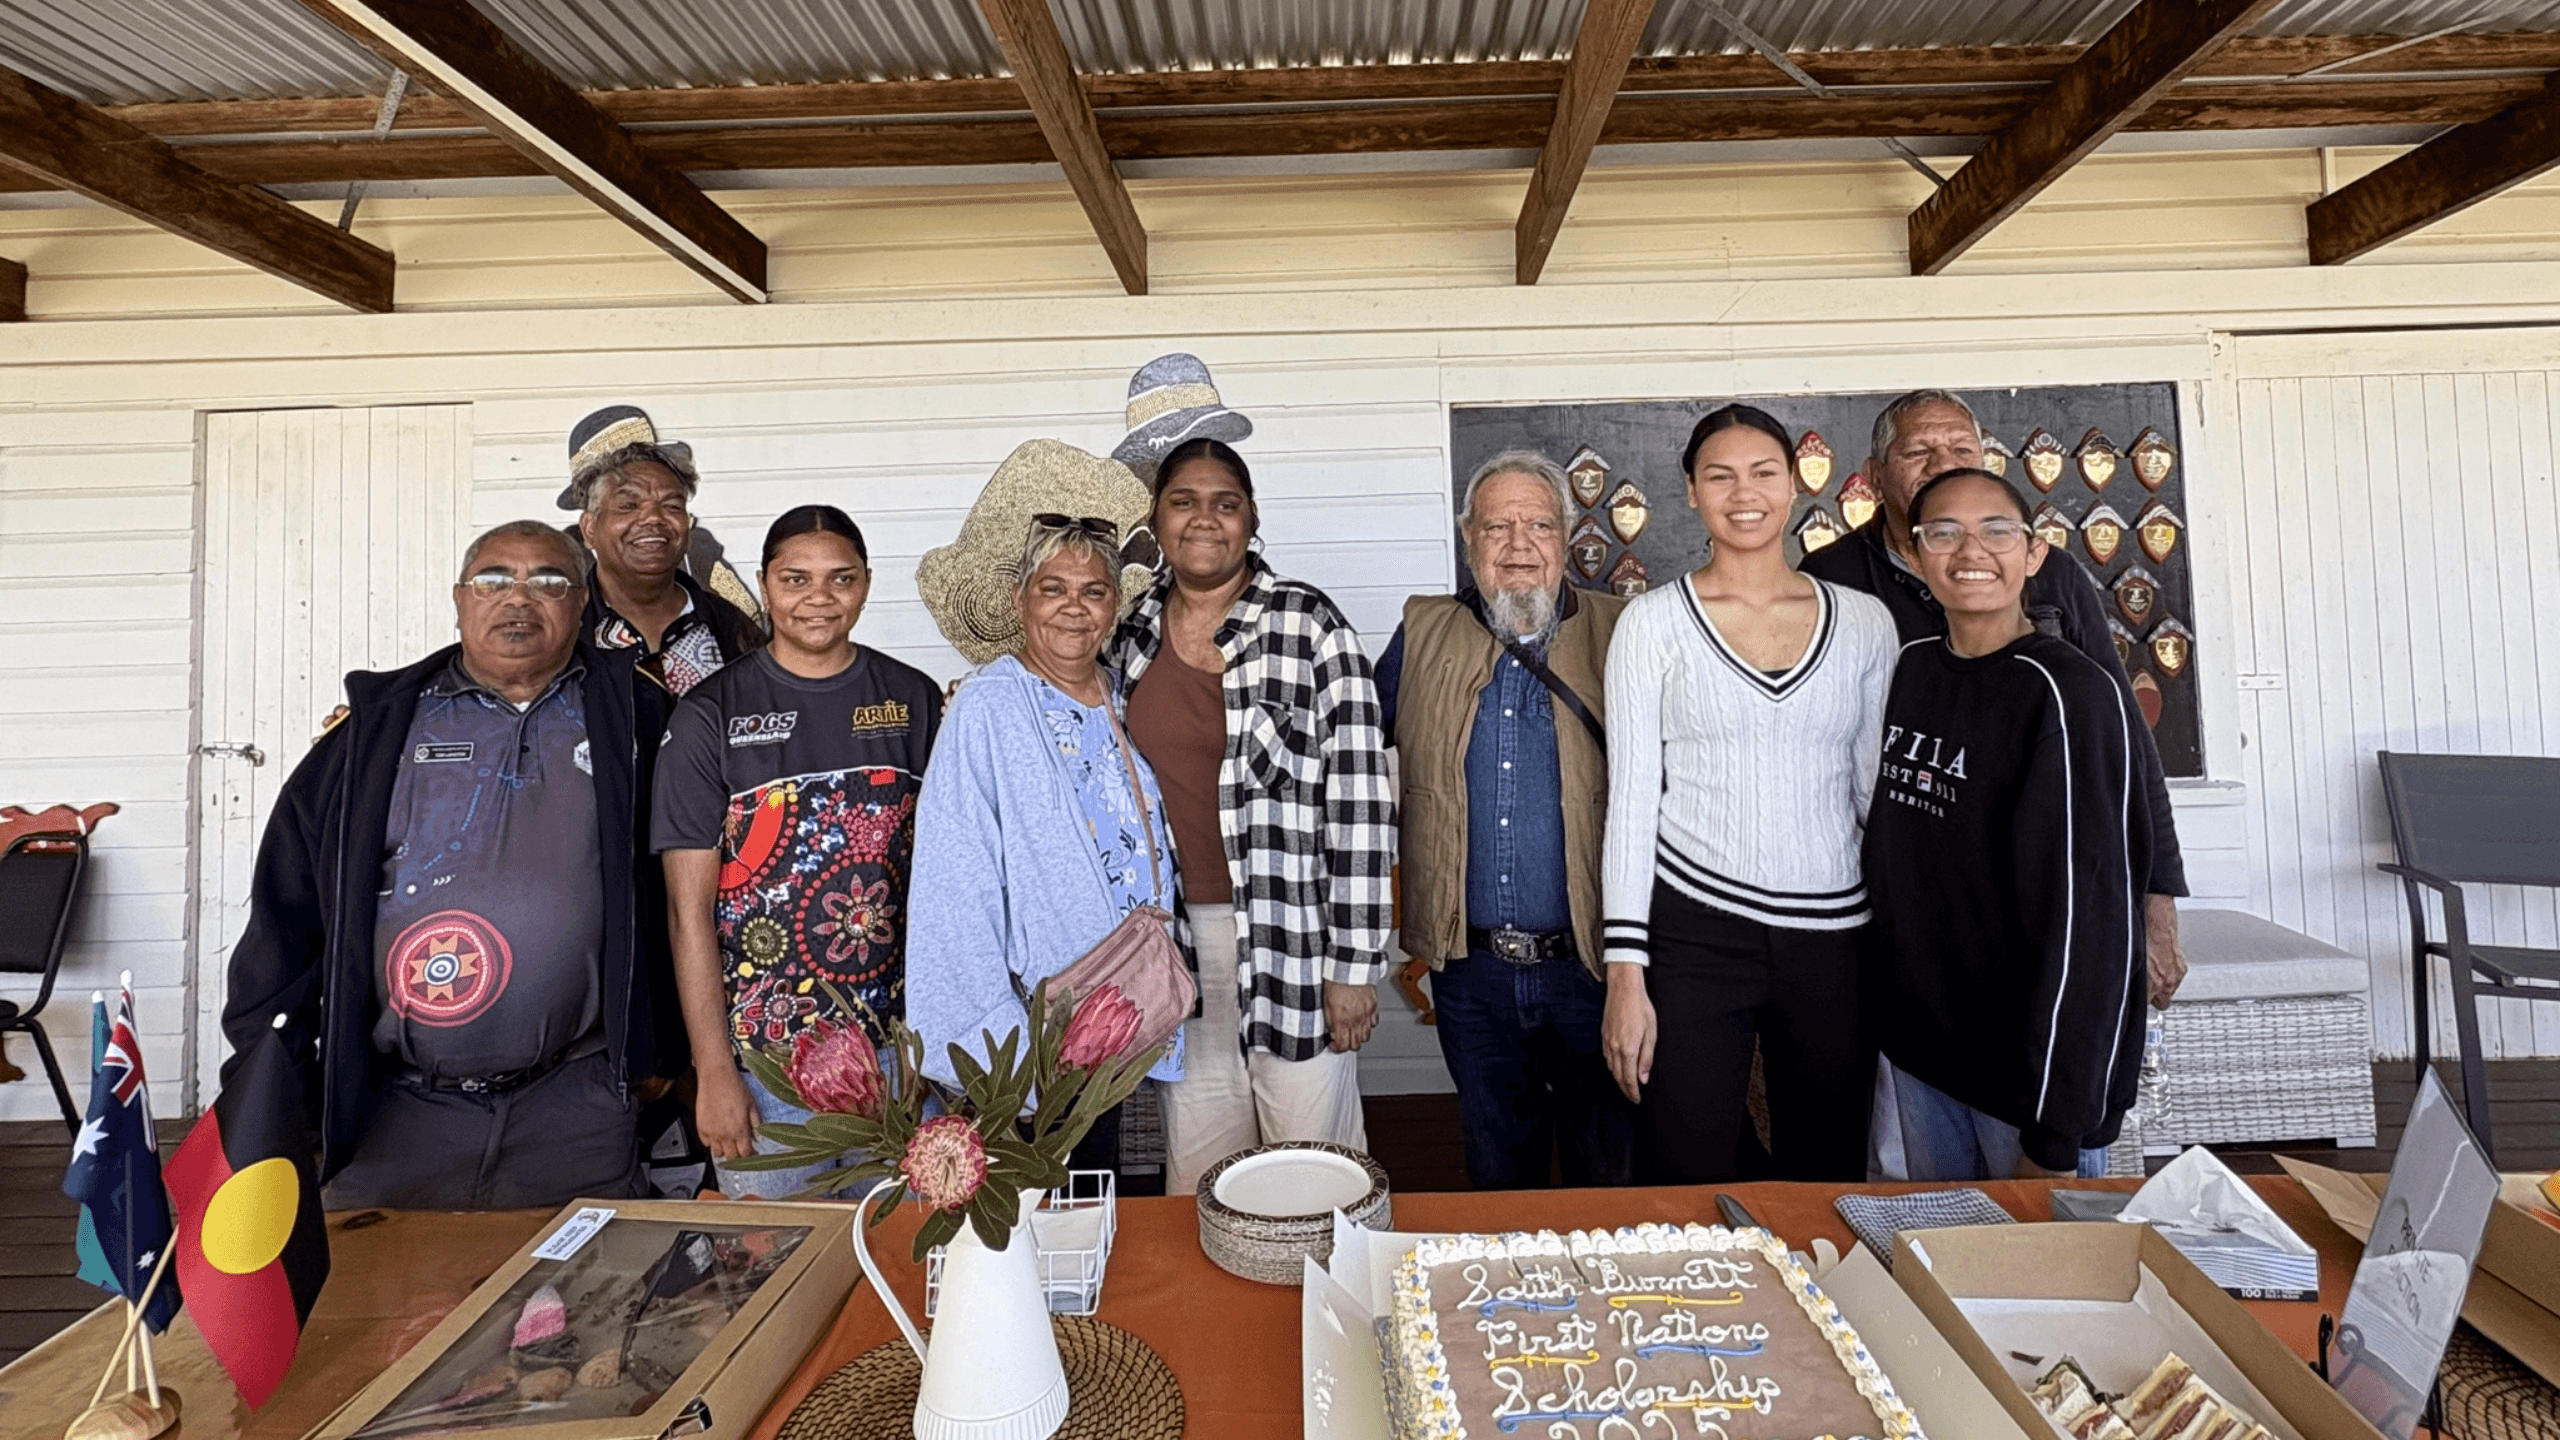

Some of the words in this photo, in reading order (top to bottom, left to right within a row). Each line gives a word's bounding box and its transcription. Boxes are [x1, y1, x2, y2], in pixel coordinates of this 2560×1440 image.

[728, 710, 798, 737] FOGS
[852, 700, 910, 726] ARTIE
[1882, 761, 1913, 784] EST
[1933, 781, 1957, 803] 911
[1888, 788, 1945, 818] HERITGE
[1457, 1263, 1586, 1310] South
[1586, 1257, 1758, 1294] Burnett
[2241, 1287, 2262, 1299] 100
[1476, 1314, 1598, 1360] First
[1607, 1308, 1769, 1348] Nations
[1490, 1355, 1781, 1418] Scholarship
